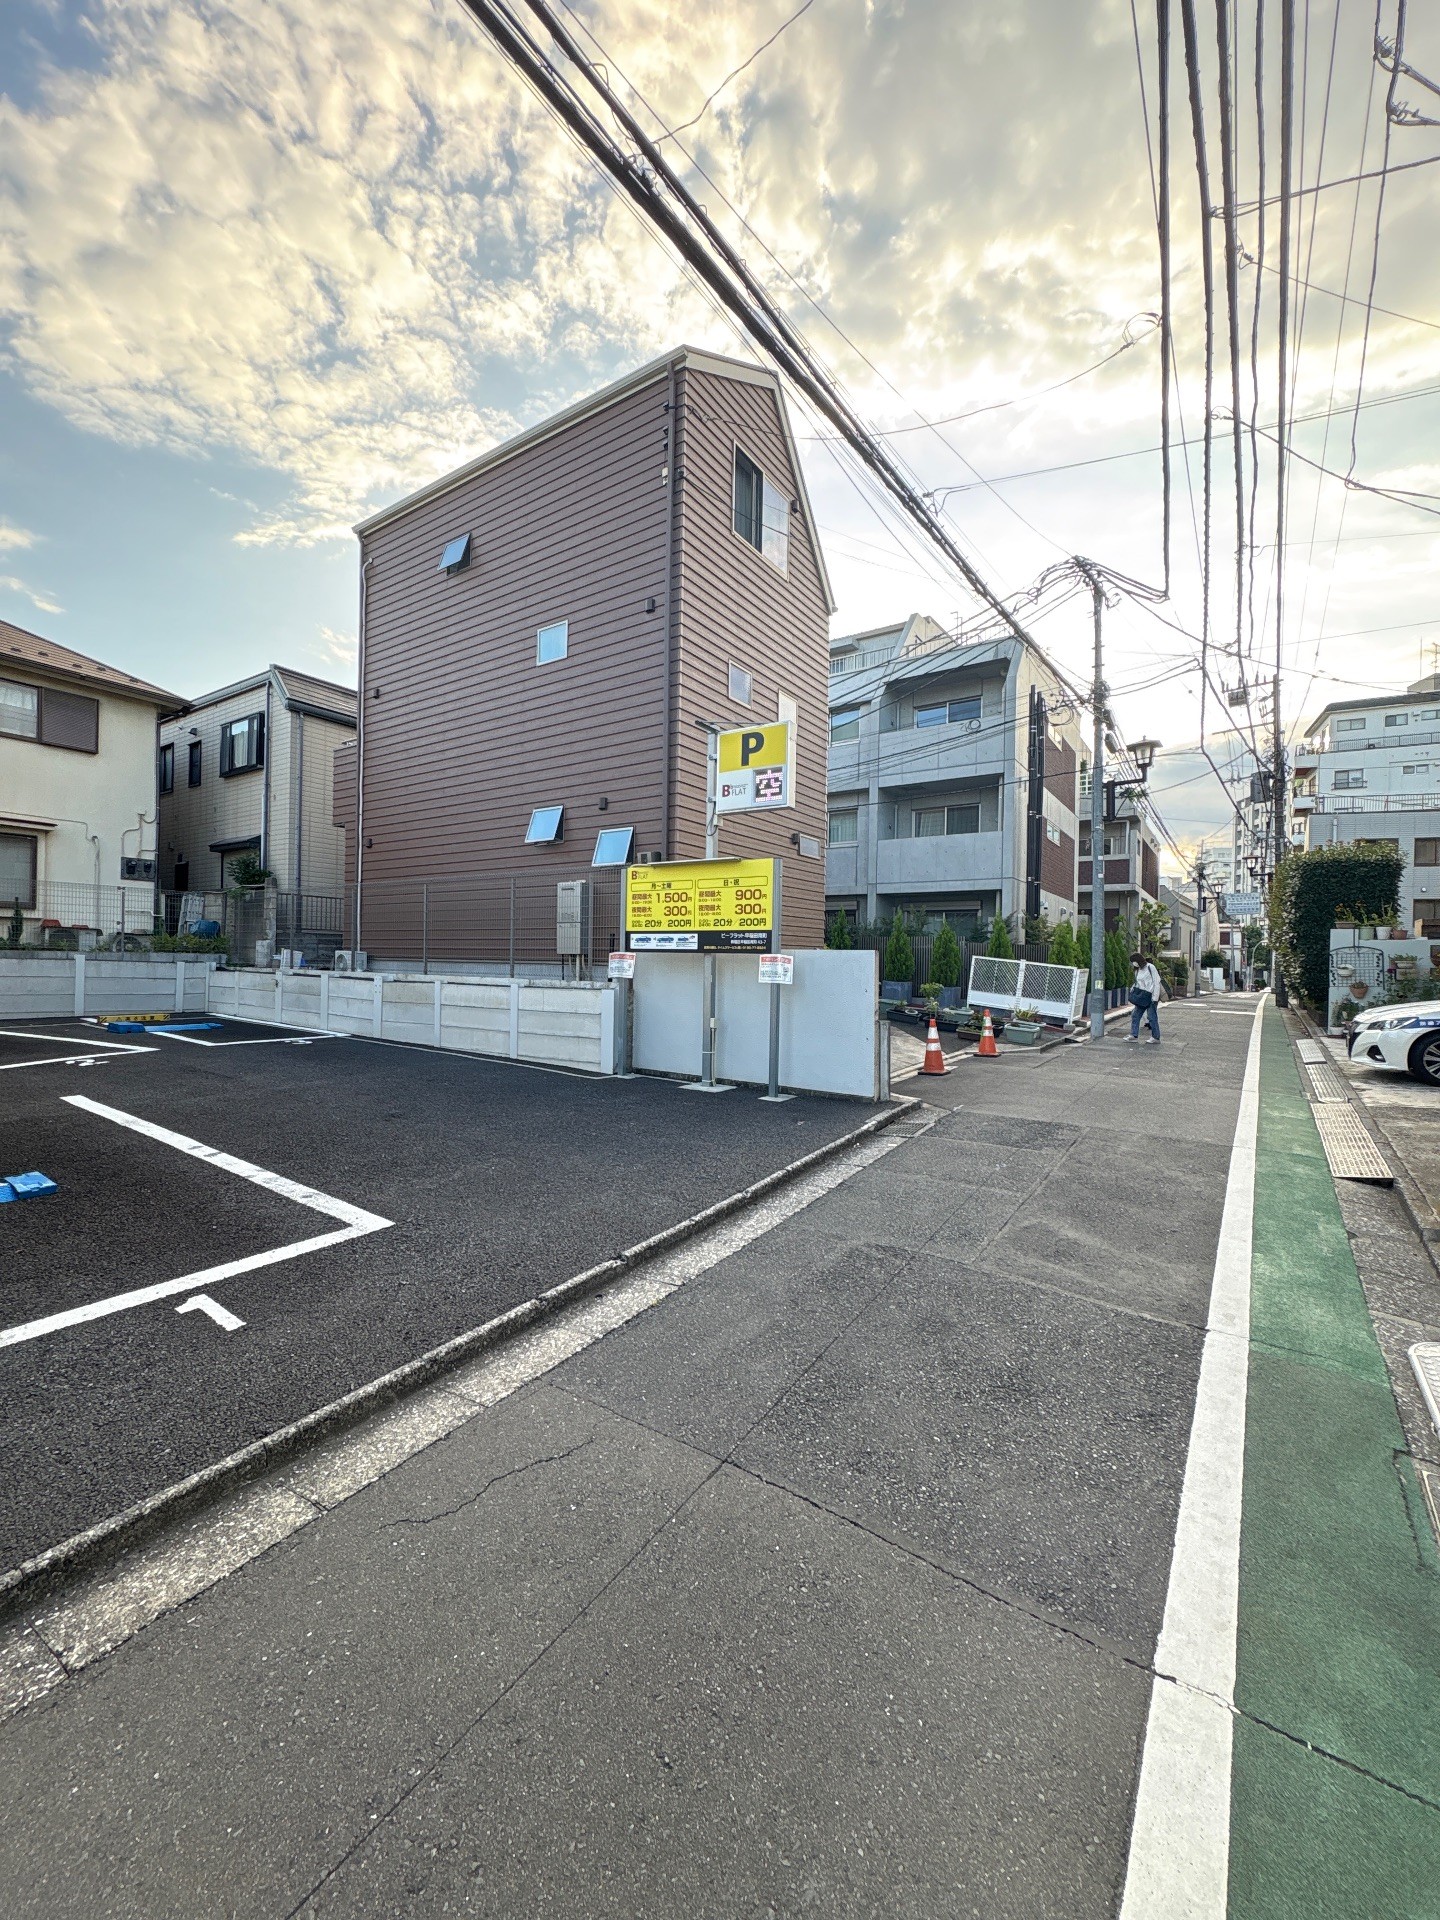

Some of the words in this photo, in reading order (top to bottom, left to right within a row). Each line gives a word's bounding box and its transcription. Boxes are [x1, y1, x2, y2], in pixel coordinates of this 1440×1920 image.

[741, 731, 765, 767] P
[755, 769, 783, 803] 空
[735, 888, 767, 901] 900円
[664, 905, 692, 917] 300円
[735, 903, 767, 915] 300円
[174, 1293, 248, 1332] 1
